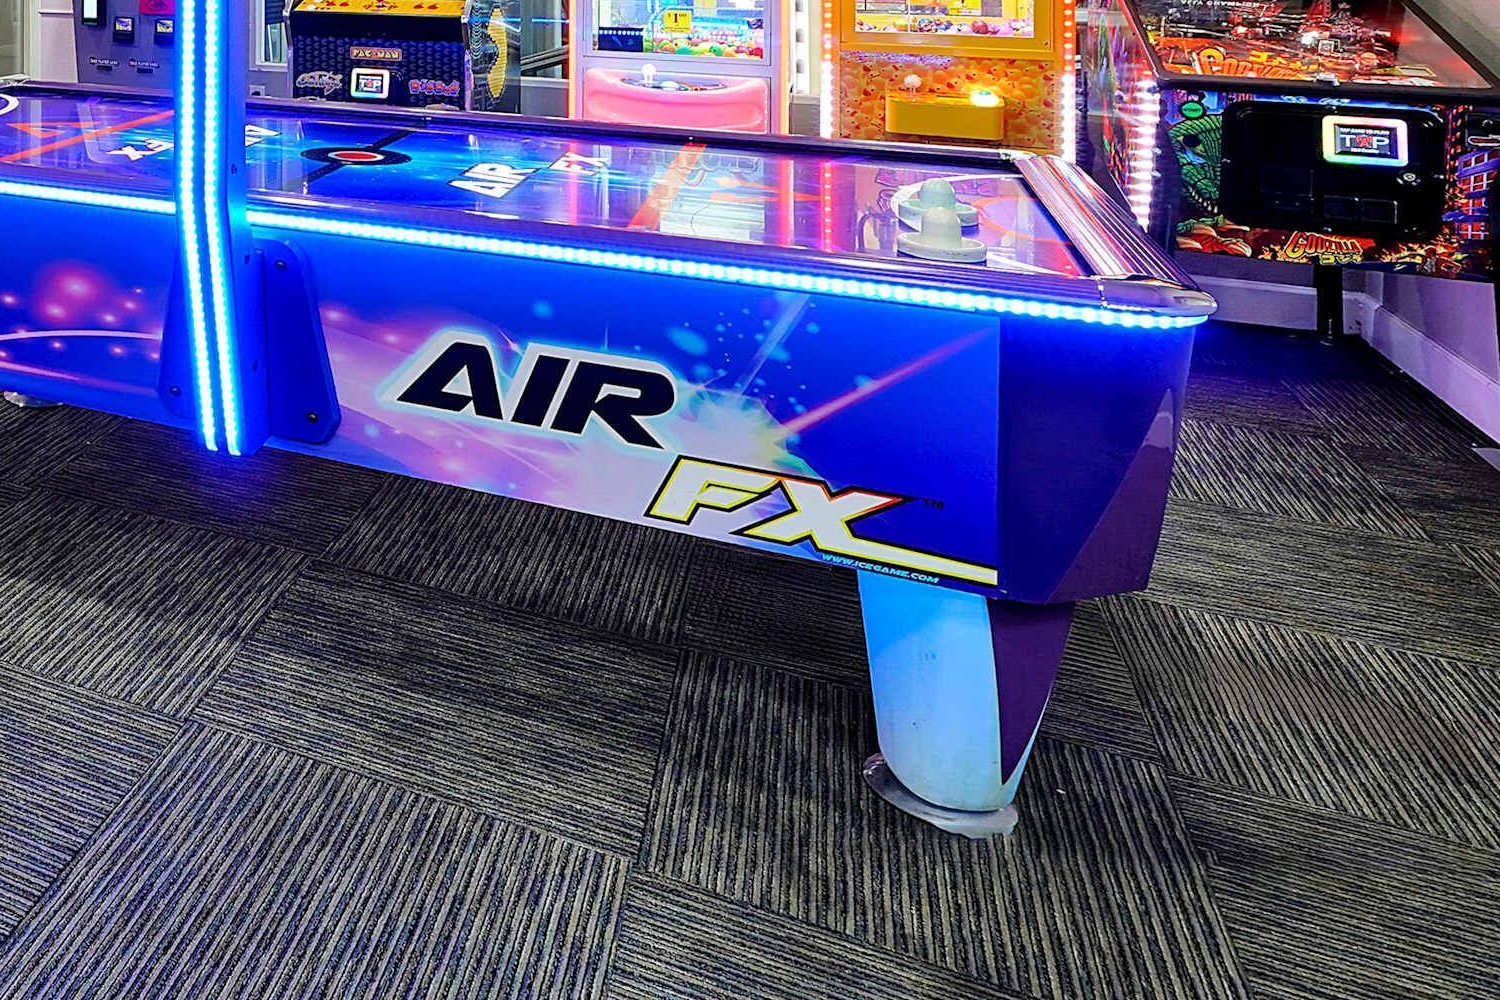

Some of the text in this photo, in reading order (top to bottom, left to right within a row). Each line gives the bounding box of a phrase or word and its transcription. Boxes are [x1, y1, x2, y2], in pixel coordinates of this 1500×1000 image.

[446, 162, 541, 199] AIR
[392, 338, 676, 450] AIR
[644, 454, 998, 586] FX
[820, 553, 940, 584] WWW.ICEGAME.COM
